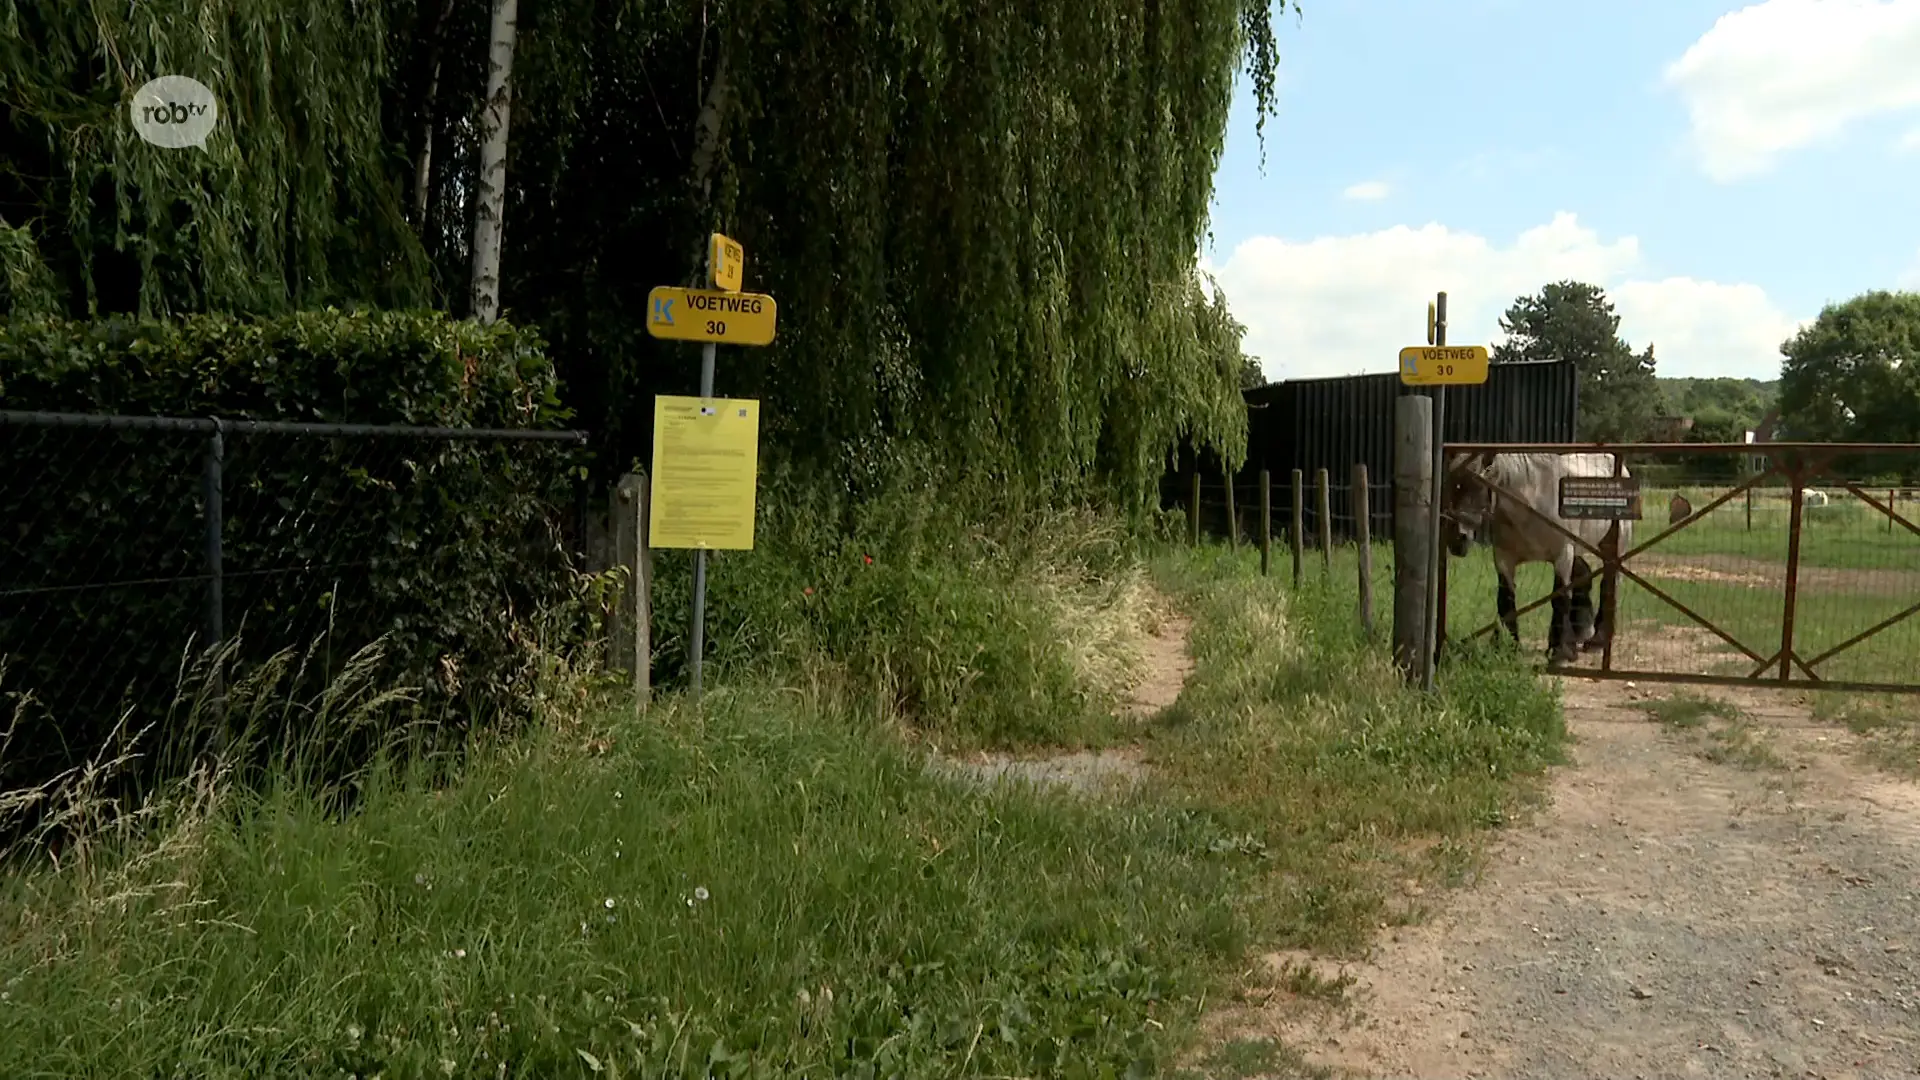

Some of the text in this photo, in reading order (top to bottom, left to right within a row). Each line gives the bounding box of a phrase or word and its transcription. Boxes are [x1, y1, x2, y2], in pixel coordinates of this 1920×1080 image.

[686, 294, 762, 314] VOETWEG
[706, 320, 726, 336] 30
[1422, 348, 1475, 361] VOETWEG
[1436, 364, 1453, 376] 30
